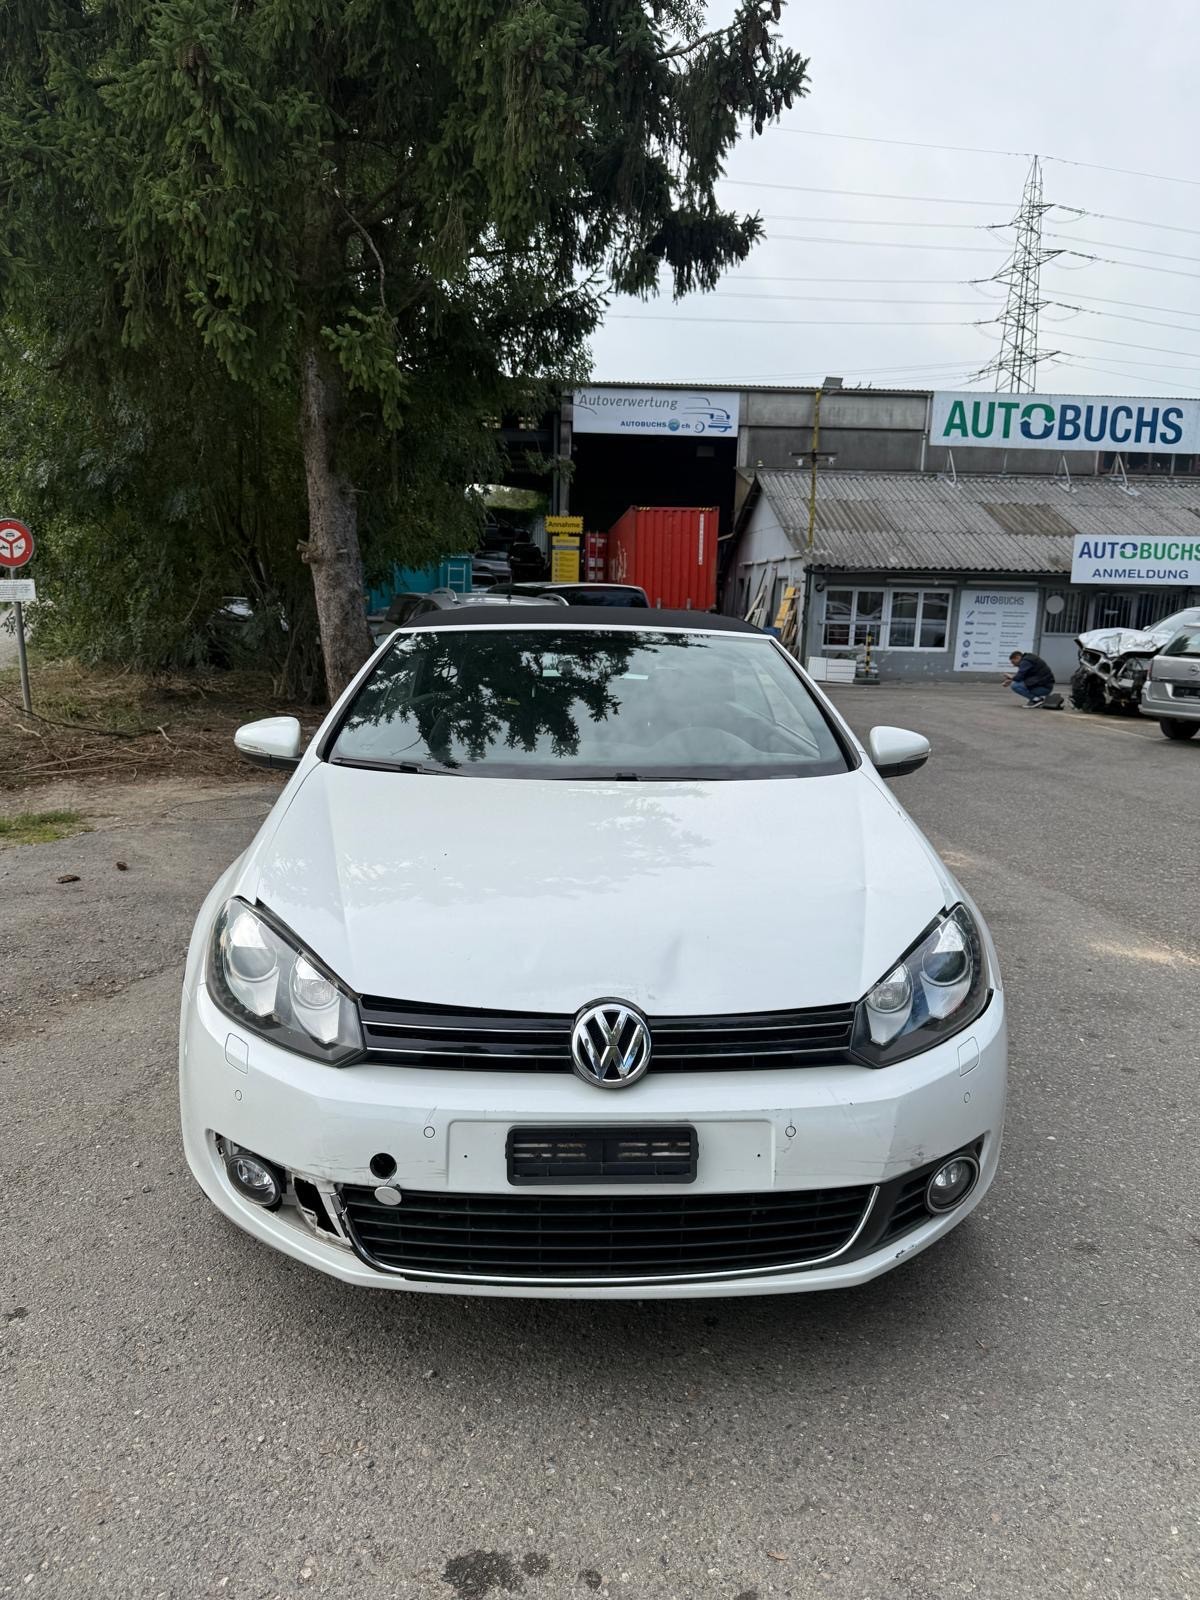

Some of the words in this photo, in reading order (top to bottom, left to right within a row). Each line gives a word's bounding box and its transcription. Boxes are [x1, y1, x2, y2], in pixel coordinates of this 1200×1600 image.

[579, 395, 678, 410] Autoverwertung
[942, 400, 1184, 444] AUTOBUCHS
[1092, 569, 1189, 580] ANMELDUNG
[974, 595, 1025, 606] AUTOBUCHS
[576, 1008, 646, 1082] VW
